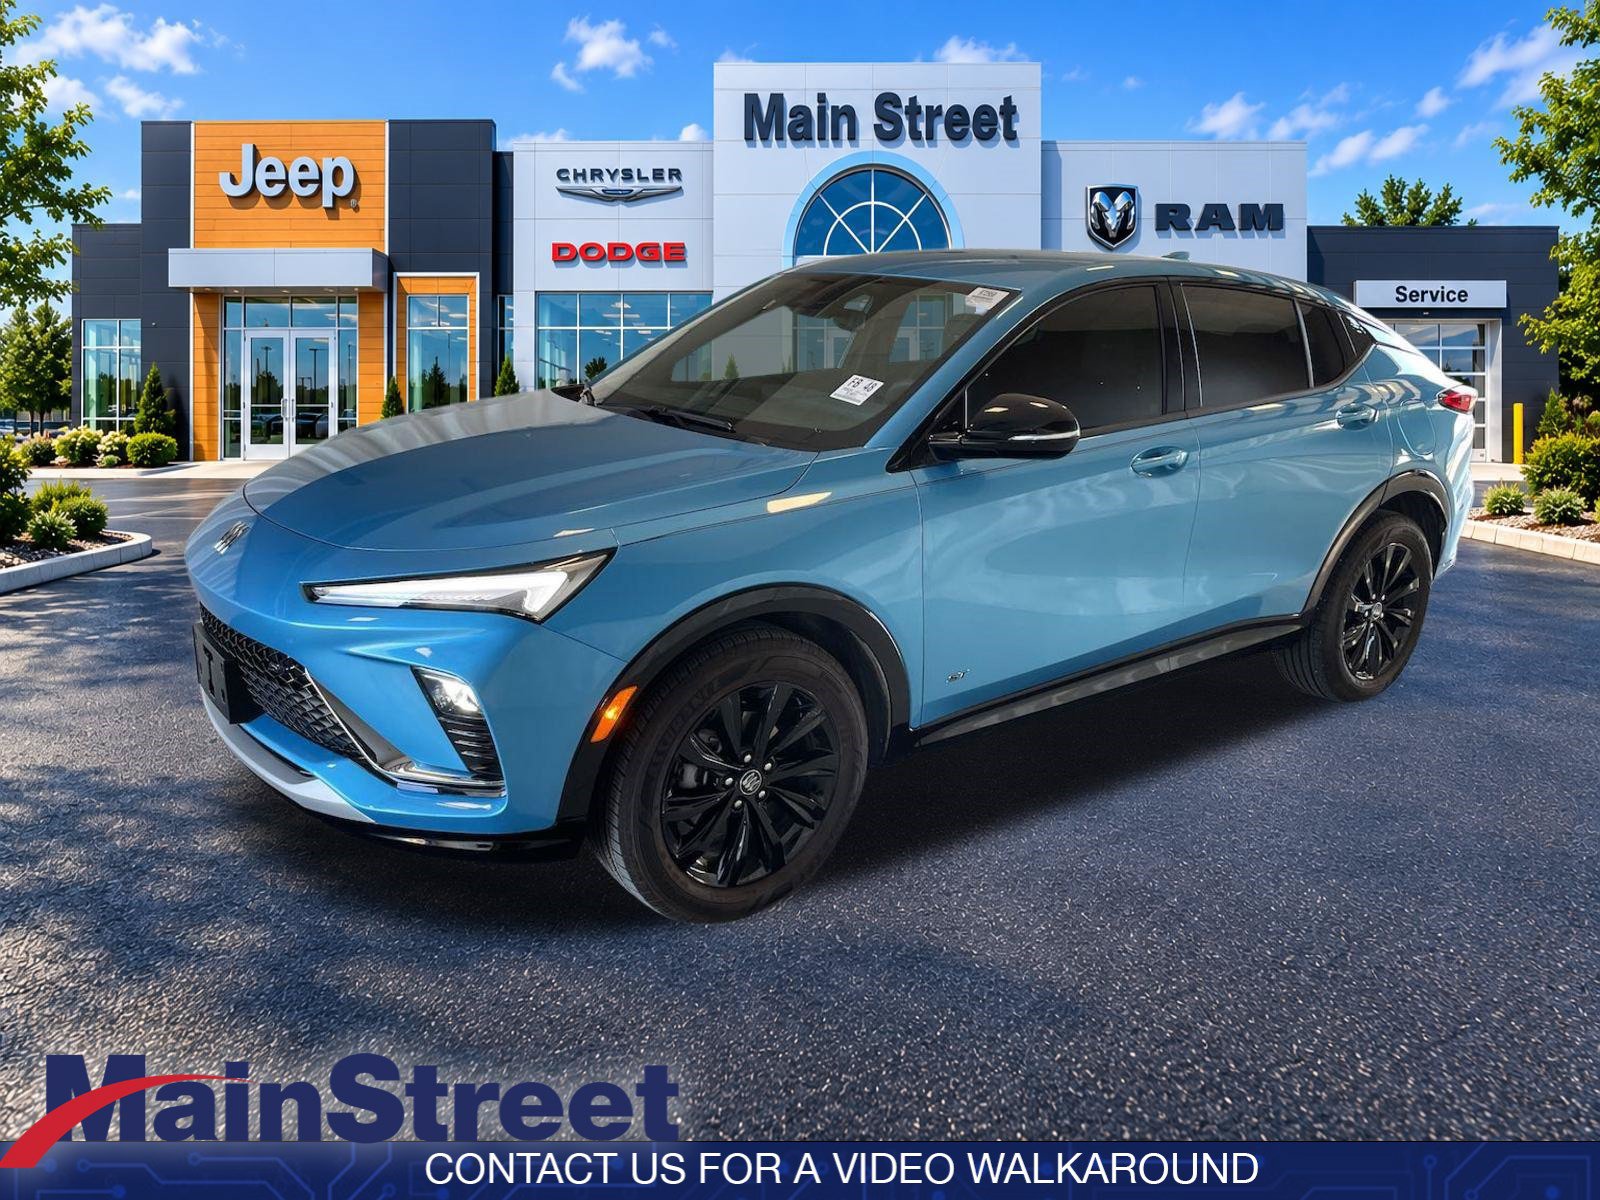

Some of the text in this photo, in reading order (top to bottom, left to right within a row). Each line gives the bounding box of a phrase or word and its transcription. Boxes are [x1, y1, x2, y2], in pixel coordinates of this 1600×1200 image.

[744, 91, 1018, 142] Main Street
[218, 143, 355, 208] Jeep
[556, 168, 683, 182] CHRYSLER
[1155, 203, 1284, 231] RAM
[551, 242, 686, 262] DODGE
[1395, 285, 1469, 303] Service
